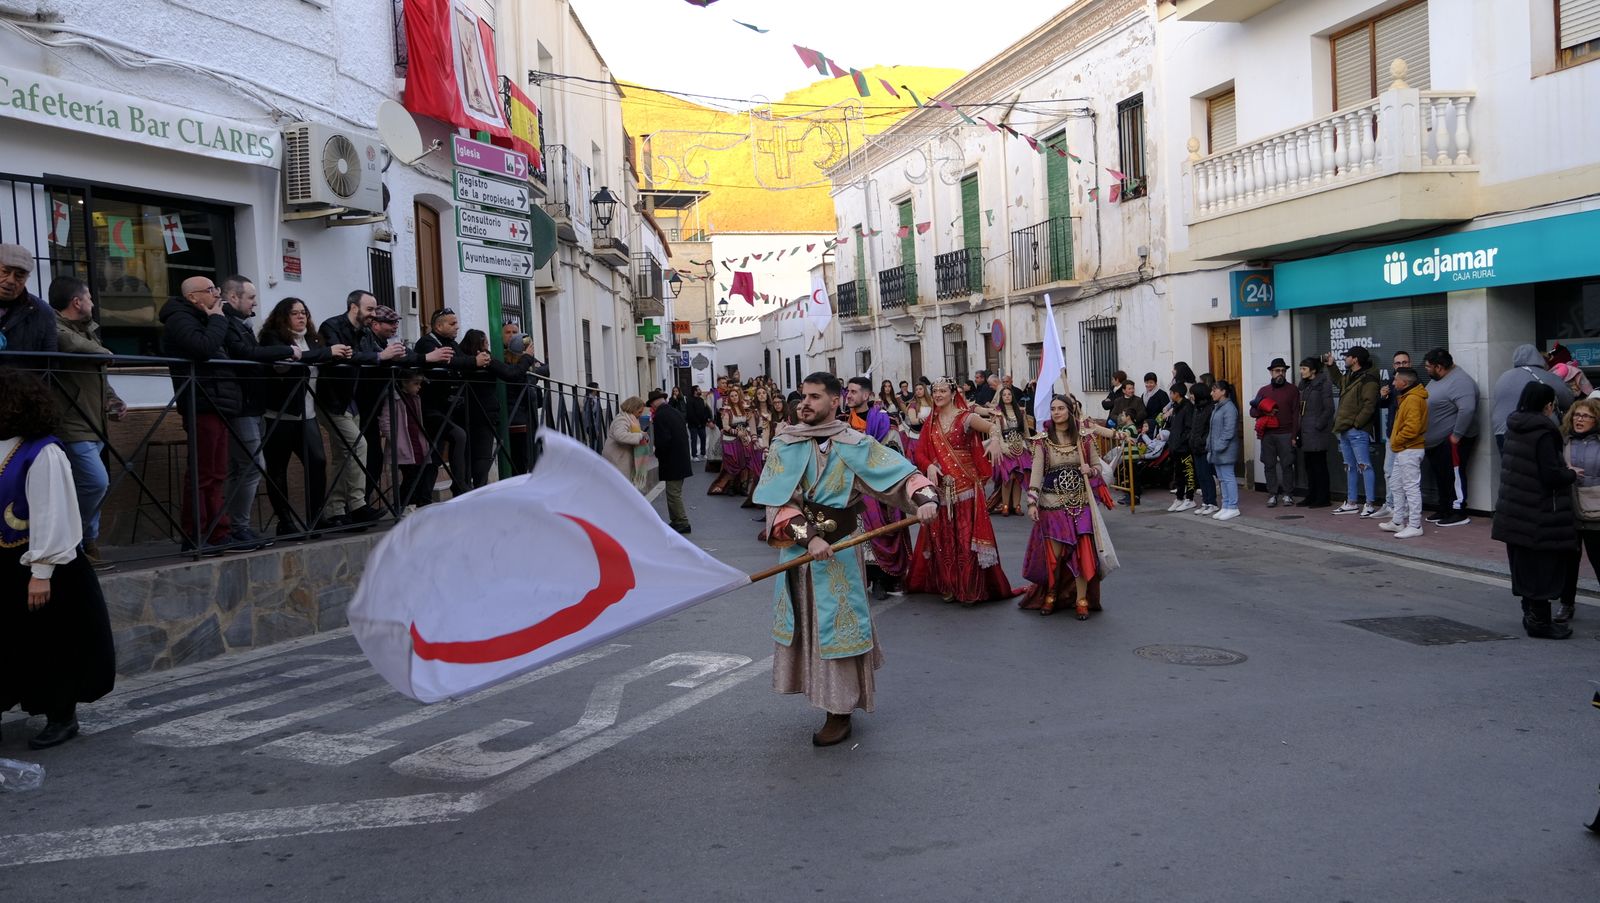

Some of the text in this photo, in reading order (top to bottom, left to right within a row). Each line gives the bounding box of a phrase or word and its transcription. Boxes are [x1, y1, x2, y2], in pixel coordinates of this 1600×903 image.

[127, 105, 170, 140] Bar
[177, 118, 275, 159] CLARES
[457, 144, 480, 160] Iglesia
[459, 174, 488, 190] Registro
[460, 186, 515, 208] de la propiedad
[462, 212, 501, 227] Consultorio
[462, 224, 487, 237] médico
[465, 251, 512, 267] Ayuntamiento
[1412, 248, 1498, 281] cajamar
[1453, 270, 1496, 281] CAJA RURAL
[1330, 316, 1366, 328] NOS UNE
[1330, 329, 1345, 339] SER
